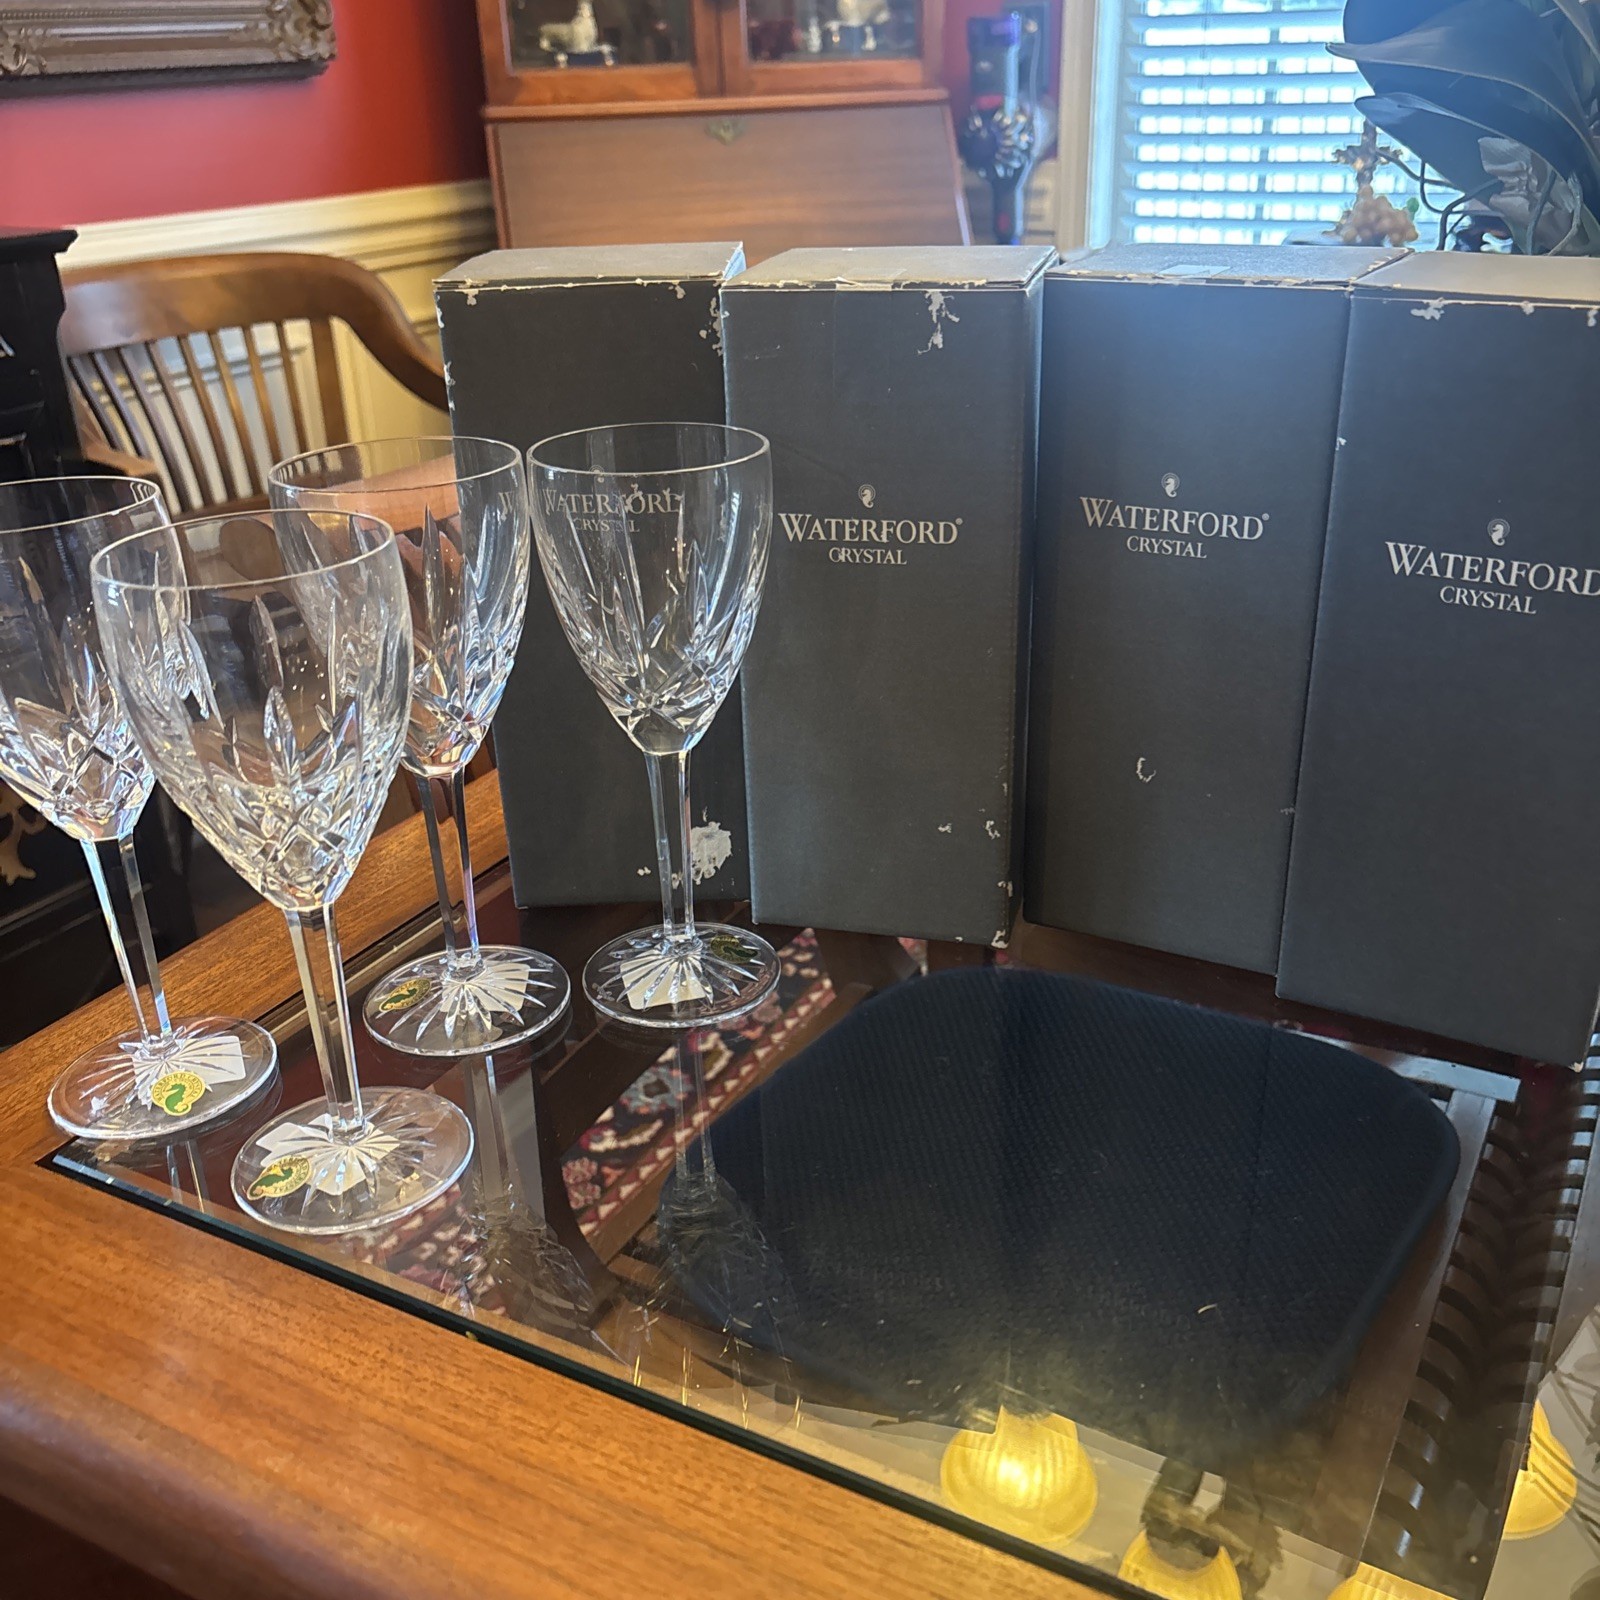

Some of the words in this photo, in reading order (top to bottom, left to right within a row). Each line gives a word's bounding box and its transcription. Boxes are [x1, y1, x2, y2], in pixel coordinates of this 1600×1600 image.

[543, 487, 683, 515] WATERORD
[778, 513, 959, 545] WATERFORD
[1080, 496, 1264, 541] WATERFORD
[828, 547, 907, 565] CRYSTAL
[1126, 535, 1207, 559] CRYSTAL
[1384, 541, 1600, 597] WATERFORD
[1439, 585, 1538, 615] CRYSTAL
